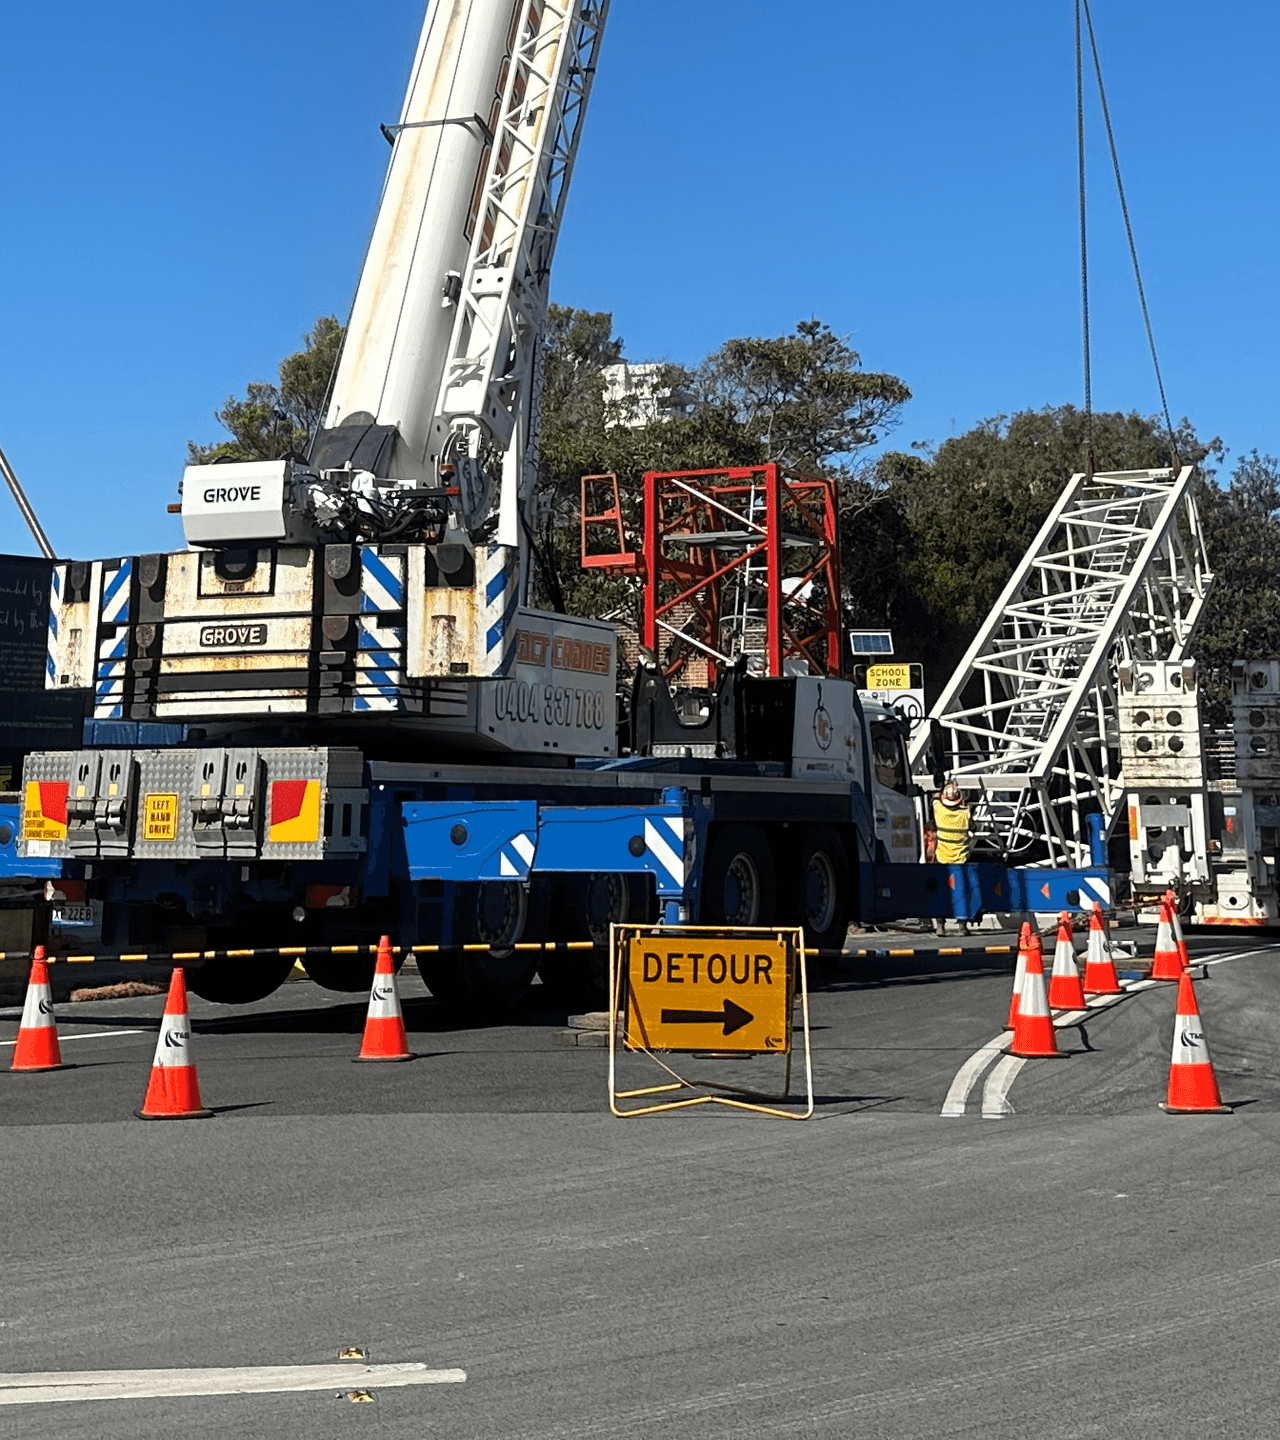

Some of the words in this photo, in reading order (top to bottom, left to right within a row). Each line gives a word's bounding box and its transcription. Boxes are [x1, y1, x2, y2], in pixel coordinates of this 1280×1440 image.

[203, 485, 261, 503] GROVE
[202, 626, 261, 645] GROVE
[869, 667, 907, 677] SCHOOL
[875, 678, 903, 687] ZONE
[495, 680, 541, 723] 0404
[544, 684, 574, 726] 337
[575, 688, 605, 730] 788
[152, 800, 170, 810] LEFT
[150, 812, 171, 822] HAND
[149, 824, 170, 835] DRIVE
[643, 952, 773, 985] DETOUR
